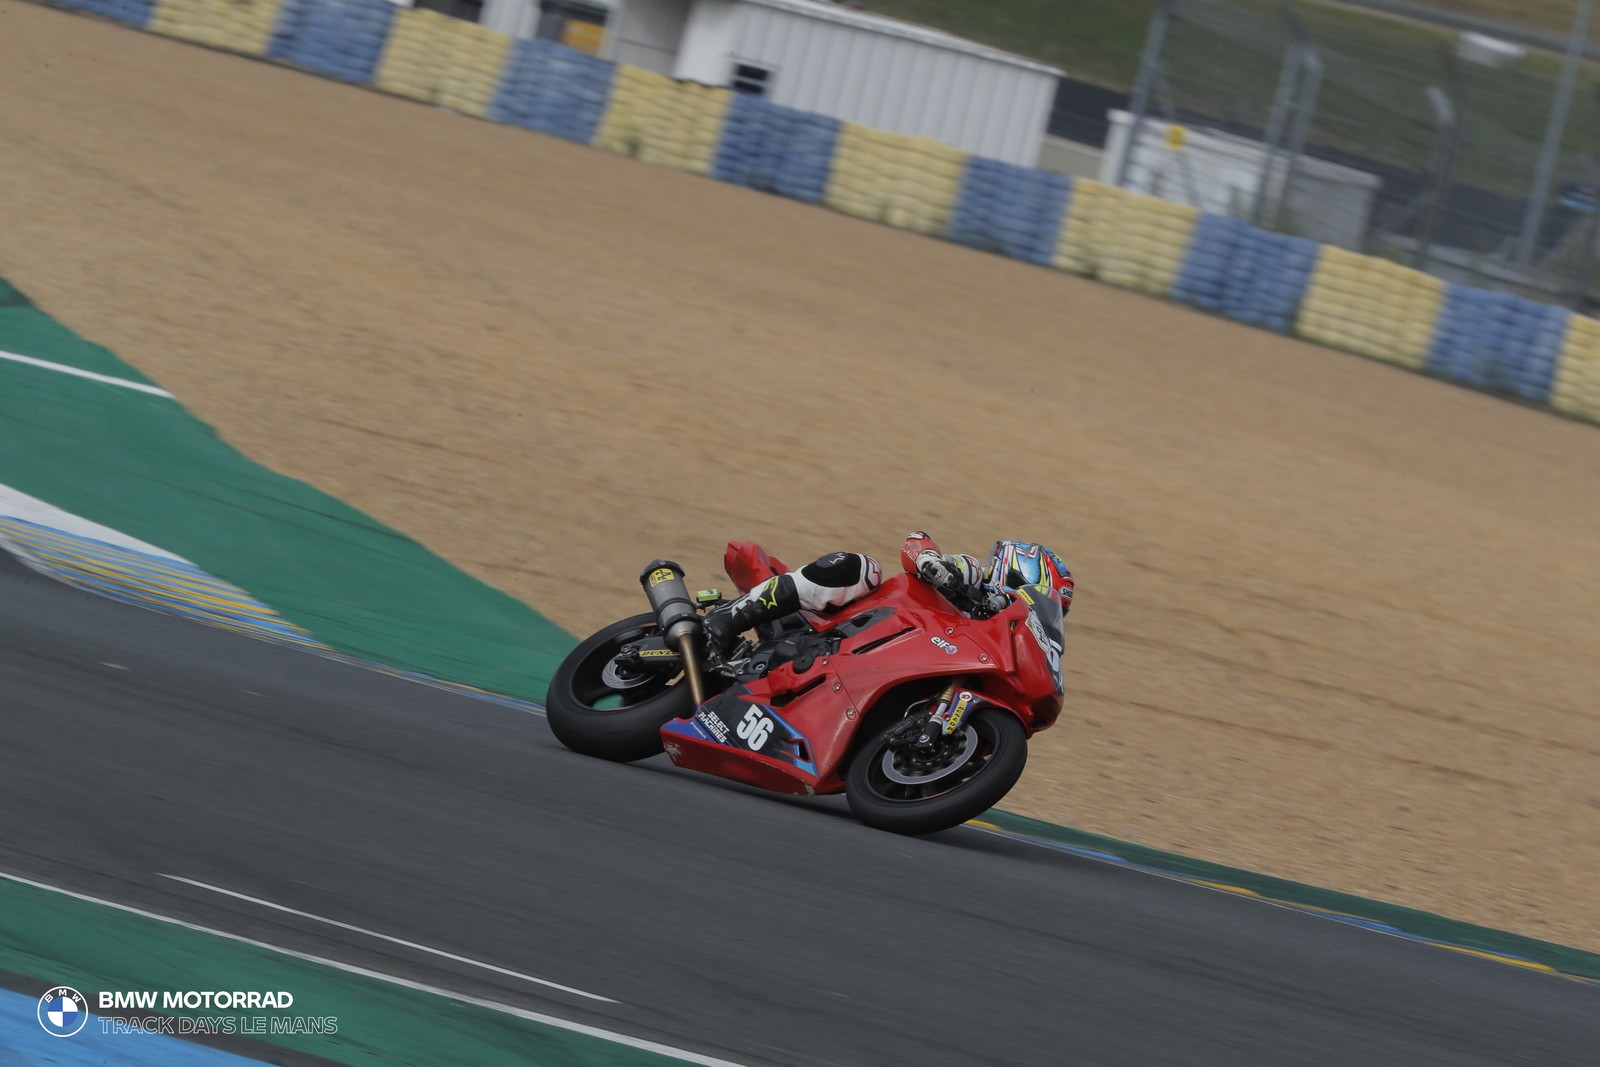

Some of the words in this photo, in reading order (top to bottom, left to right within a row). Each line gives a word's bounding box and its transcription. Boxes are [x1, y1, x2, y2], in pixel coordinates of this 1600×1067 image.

[930, 636, 951, 649] elf
[707, 710, 730, 734] SELECT
[736, 703, 775, 751] 56
[946, 705, 964, 731] DUNLOP
